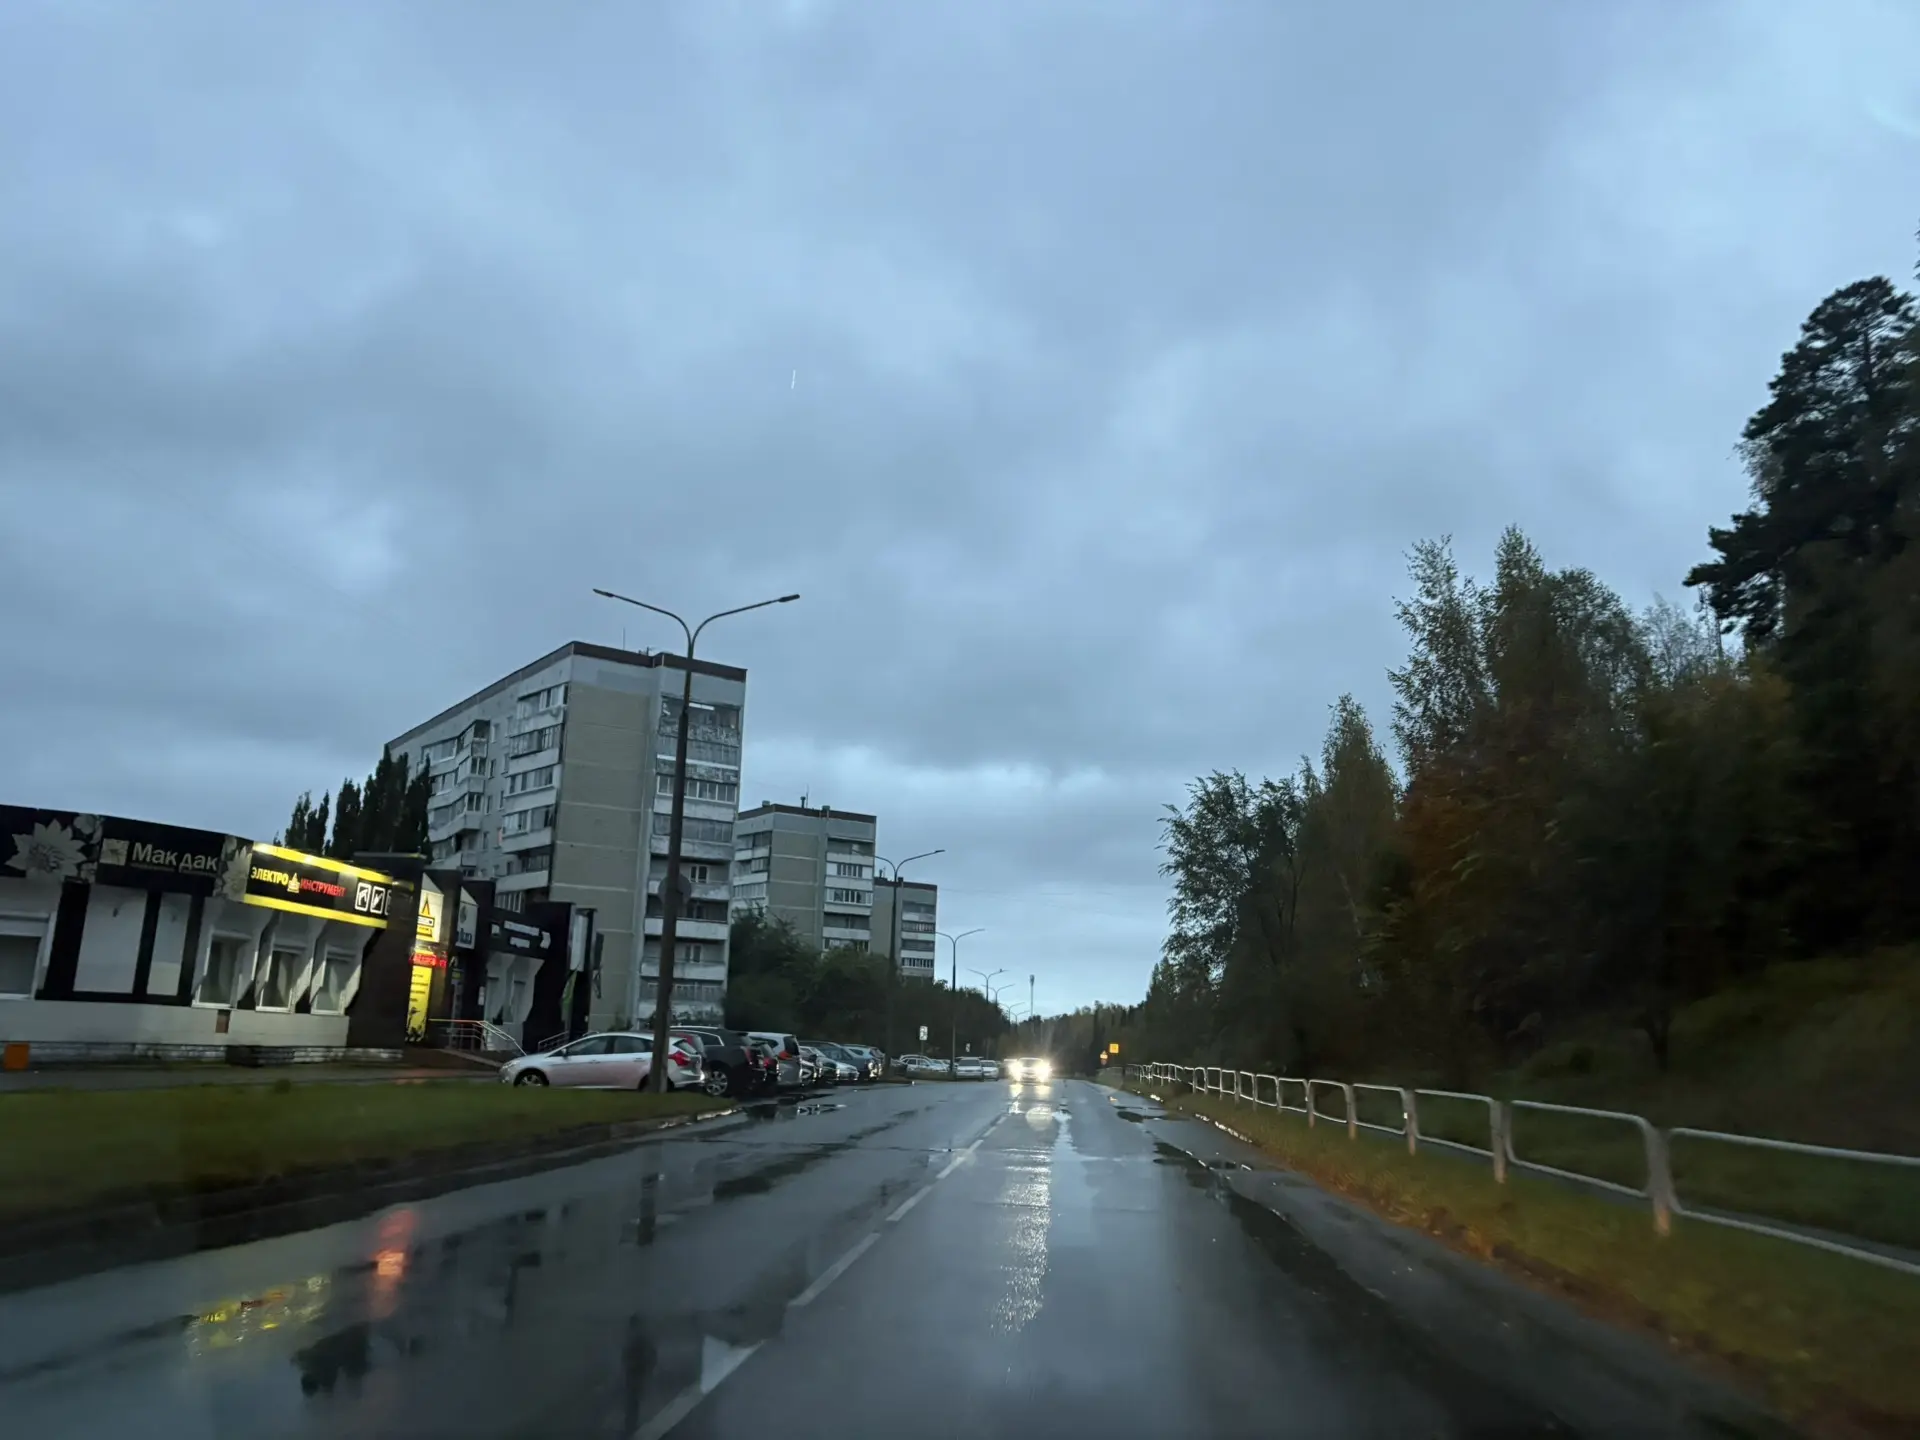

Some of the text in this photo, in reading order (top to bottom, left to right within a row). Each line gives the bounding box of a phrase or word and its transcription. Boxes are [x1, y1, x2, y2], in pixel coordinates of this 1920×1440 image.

[131, 841, 178, 866] Мак
[250, 867, 347, 897] ЭЛЕКТРО ИНСТРУМЕНТ
